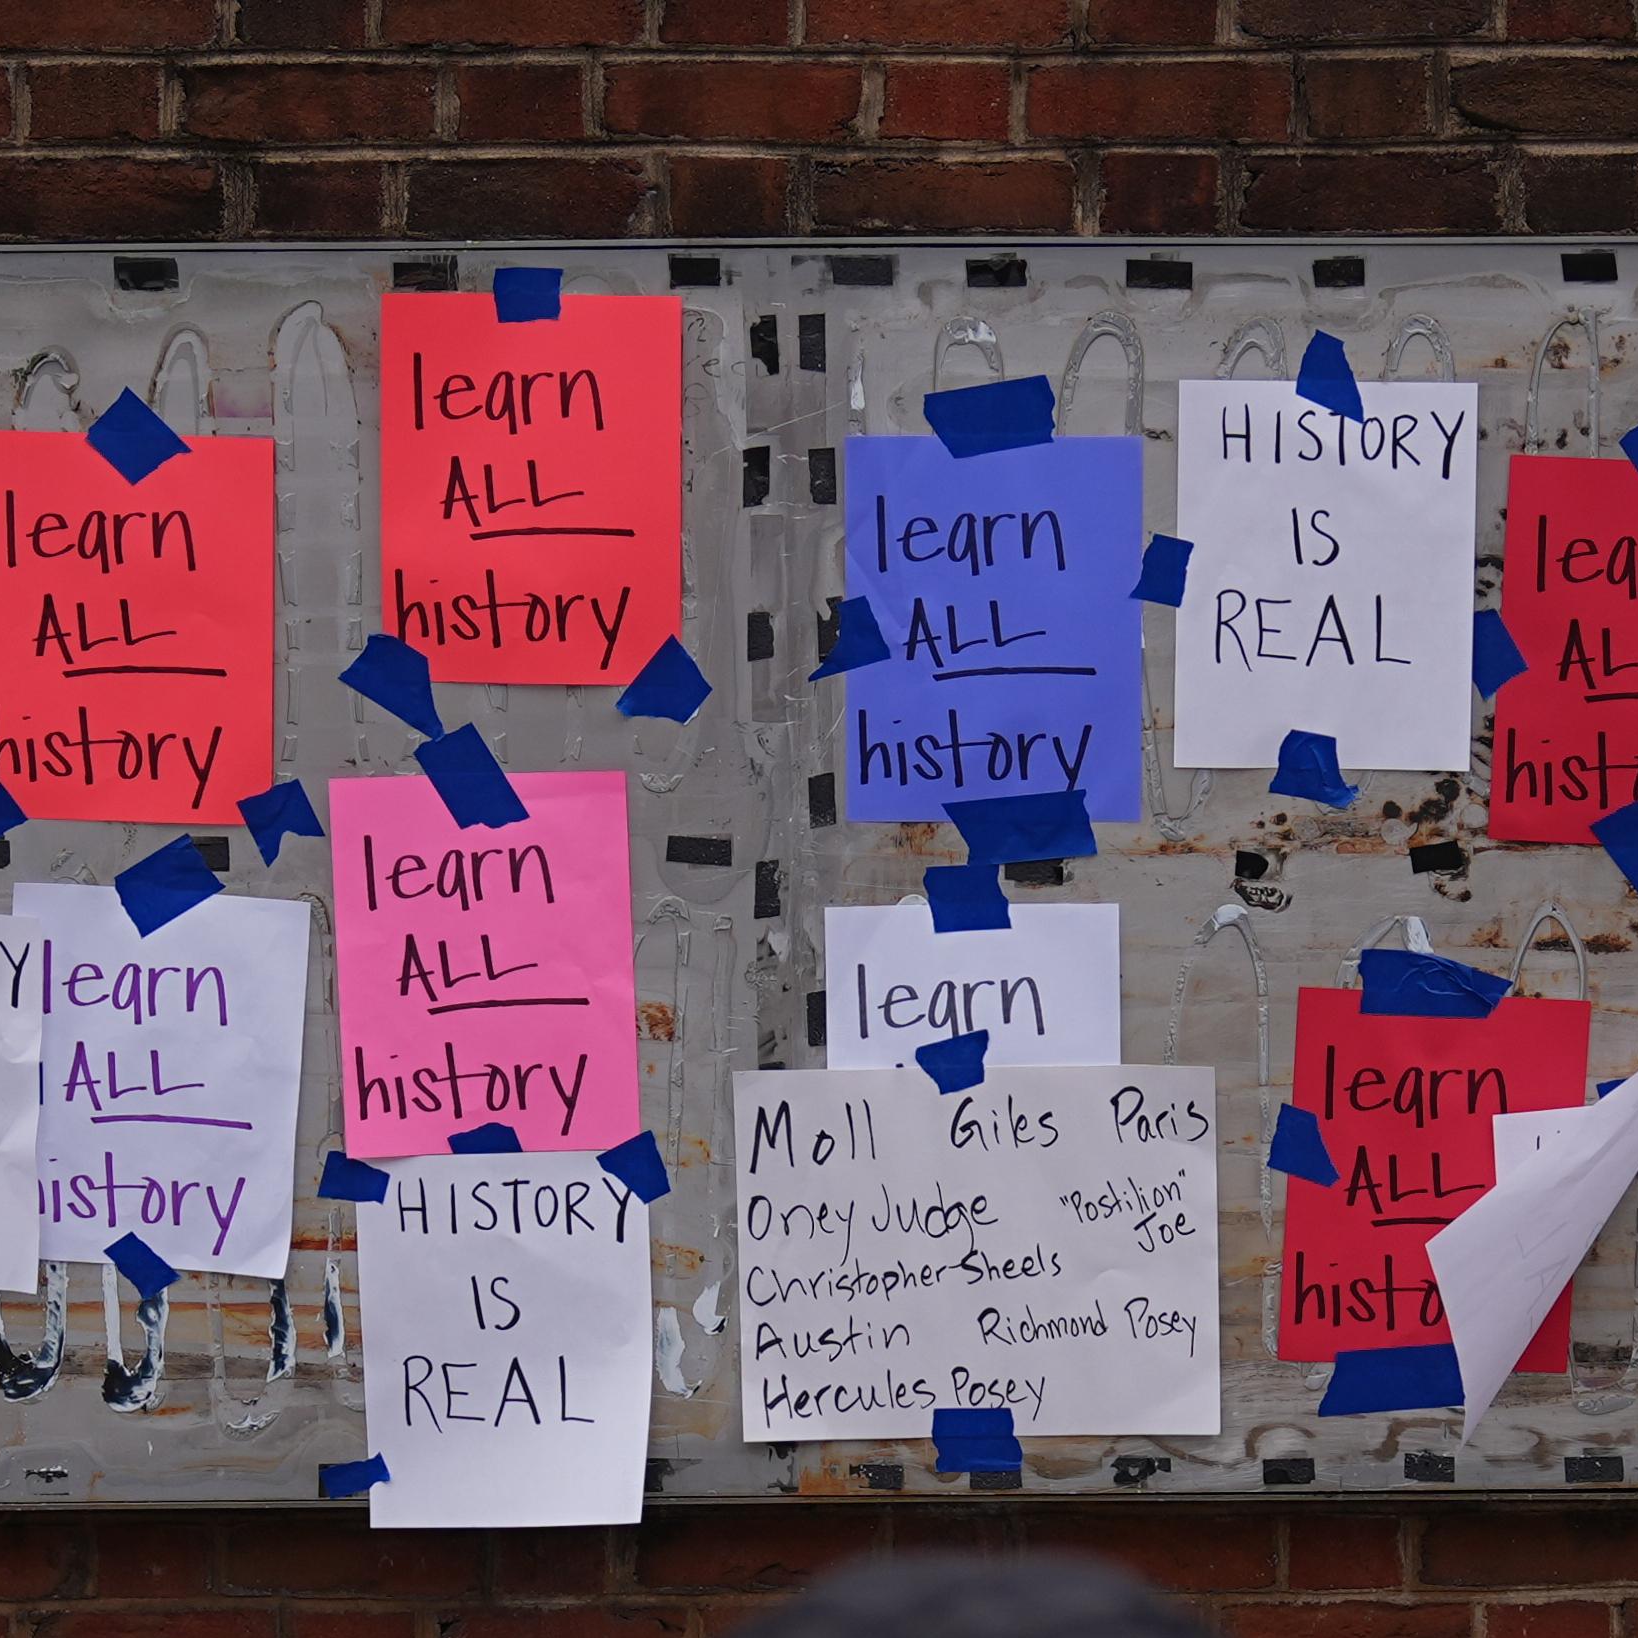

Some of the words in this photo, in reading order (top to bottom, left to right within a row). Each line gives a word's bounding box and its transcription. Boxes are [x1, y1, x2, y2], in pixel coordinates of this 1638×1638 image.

[413, 352, 604, 434] learn
[1222, 404, 1465, 479] HISTORY
[441, 456, 584, 527] ALL
[6, 490, 196, 573] learn
[877, 495, 1066, 576] learn
[1292, 508, 1340, 565] IS
[35, 594, 177, 664] ALL
[394, 569, 630, 670] history
[903, 597, 1046, 667] ALL
[1215, 589, 1411, 671] REAL
[859, 709, 1092, 791] history
[364, 835, 554, 911] learn
[43, 939, 228, 1026] learn
[396, 933, 538, 1001] ALL
[857, 963, 1045, 1038] learn
[62, 1041, 205, 1111] ALL
[355, 1042, 588, 1136] history
[1324, 1045, 1508, 1128] learn
[749, 1099, 875, 1174] Moll
[950, 1094, 1059, 1151] Giles
[1110, 1086, 1209, 1143] Paris
[397, 1177, 632, 1243] HISTORY
[1346, 1145, 1485, 1214] ALL
[748, 1194, 855, 1266] Oney
[872, 1181, 998, 1252] Judge
[1134, 1212, 1196, 1252] Joe
[471, 1275, 521, 1330] IS
[747, 1258, 948, 1306] Christopher
[961, 1243, 1061, 1284] Sheels
[1294, 1250, 1443, 1331] histo
[756, 1315, 910, 1362] Austin
[977, 1299, 1108, 1345] Richmond
[1124, 1297, 1196, 1357] Posey
[403, 1355, 594, 1433] REAL
[763, 1369, 936, 1428] Hercules
[951, 1366, 1045, 1421] Posey
